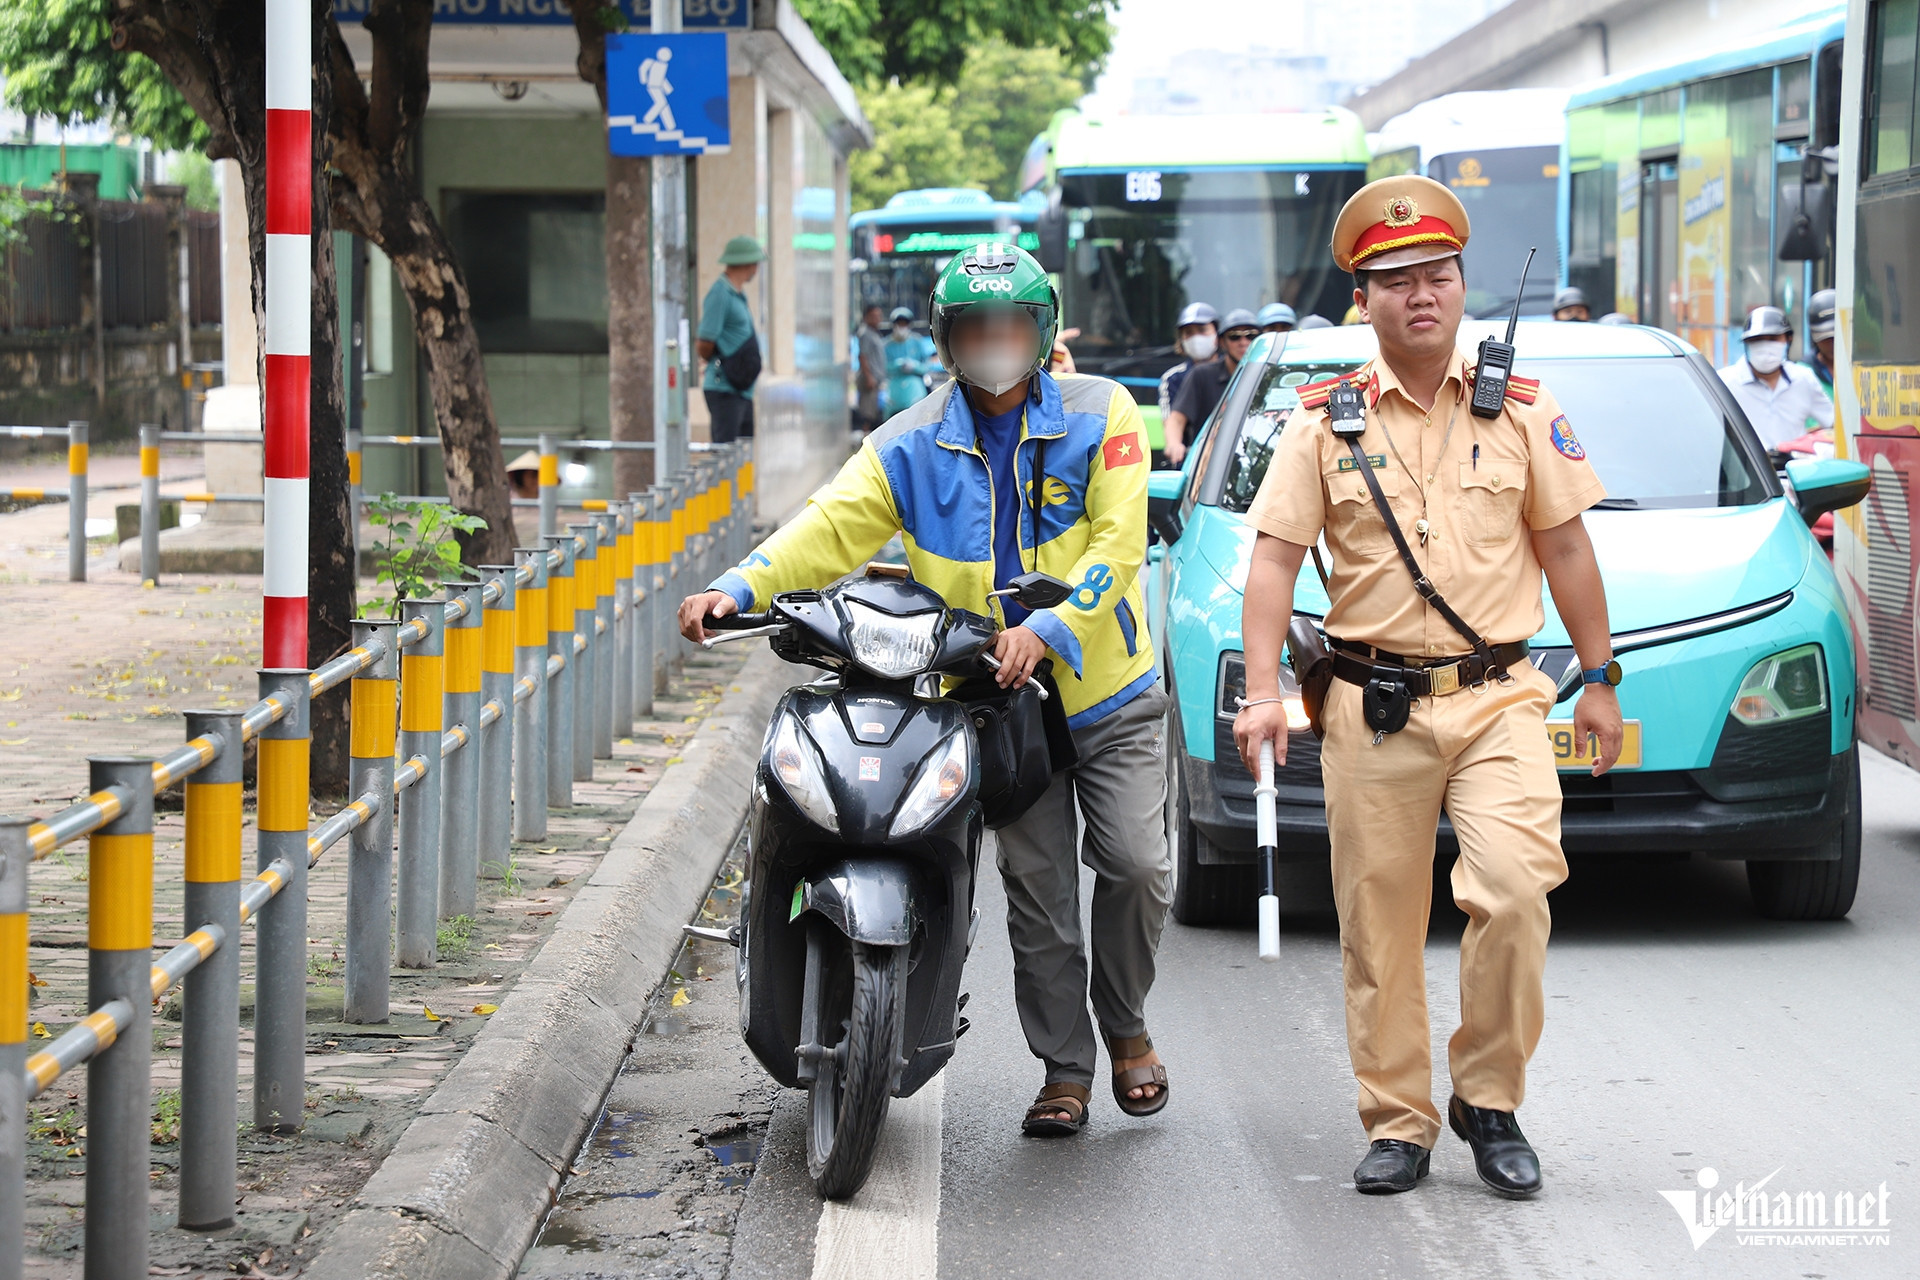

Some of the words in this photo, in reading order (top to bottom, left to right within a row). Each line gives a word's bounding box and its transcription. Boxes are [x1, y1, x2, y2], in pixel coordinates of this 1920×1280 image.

[1126, 170, 1162, 201] E05
[1295, 172, 1310, 196] K
[968, 276, 1013, 293] Grab
[856, 697, 896, 706] HONDA
